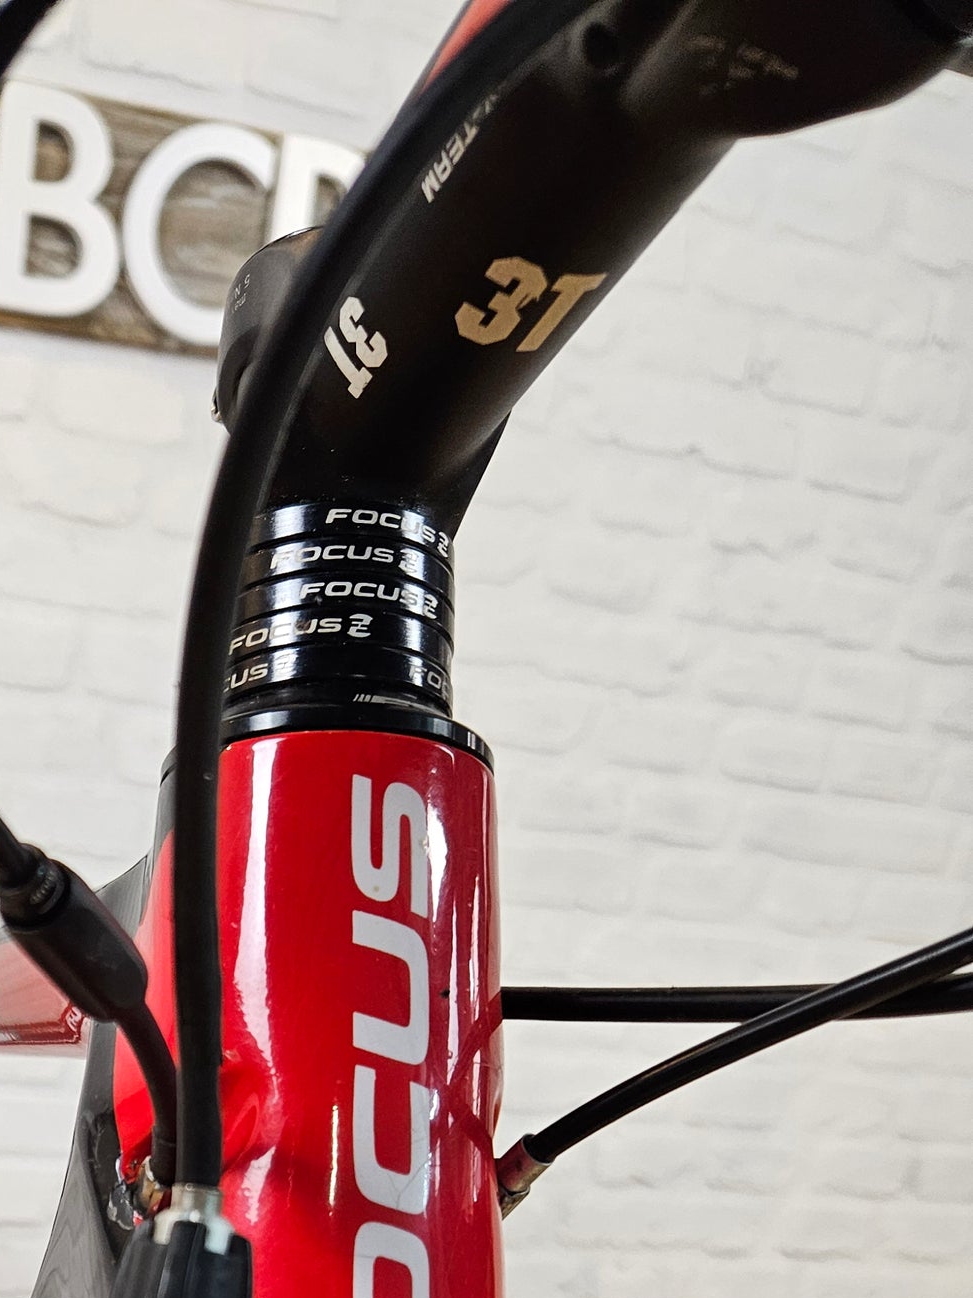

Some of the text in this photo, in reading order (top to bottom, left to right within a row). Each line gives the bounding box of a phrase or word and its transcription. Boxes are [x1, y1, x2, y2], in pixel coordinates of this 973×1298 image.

[454, 255, 608, 353] 3T
[323, 296, 389, 400] 3T
[325, 507, 436, 543] FOCUS
[269, 545, 395, 570] FOCUS
[298, 581, 422, 607] FOCUS
[228, 616, 343, 656] FOCUS
